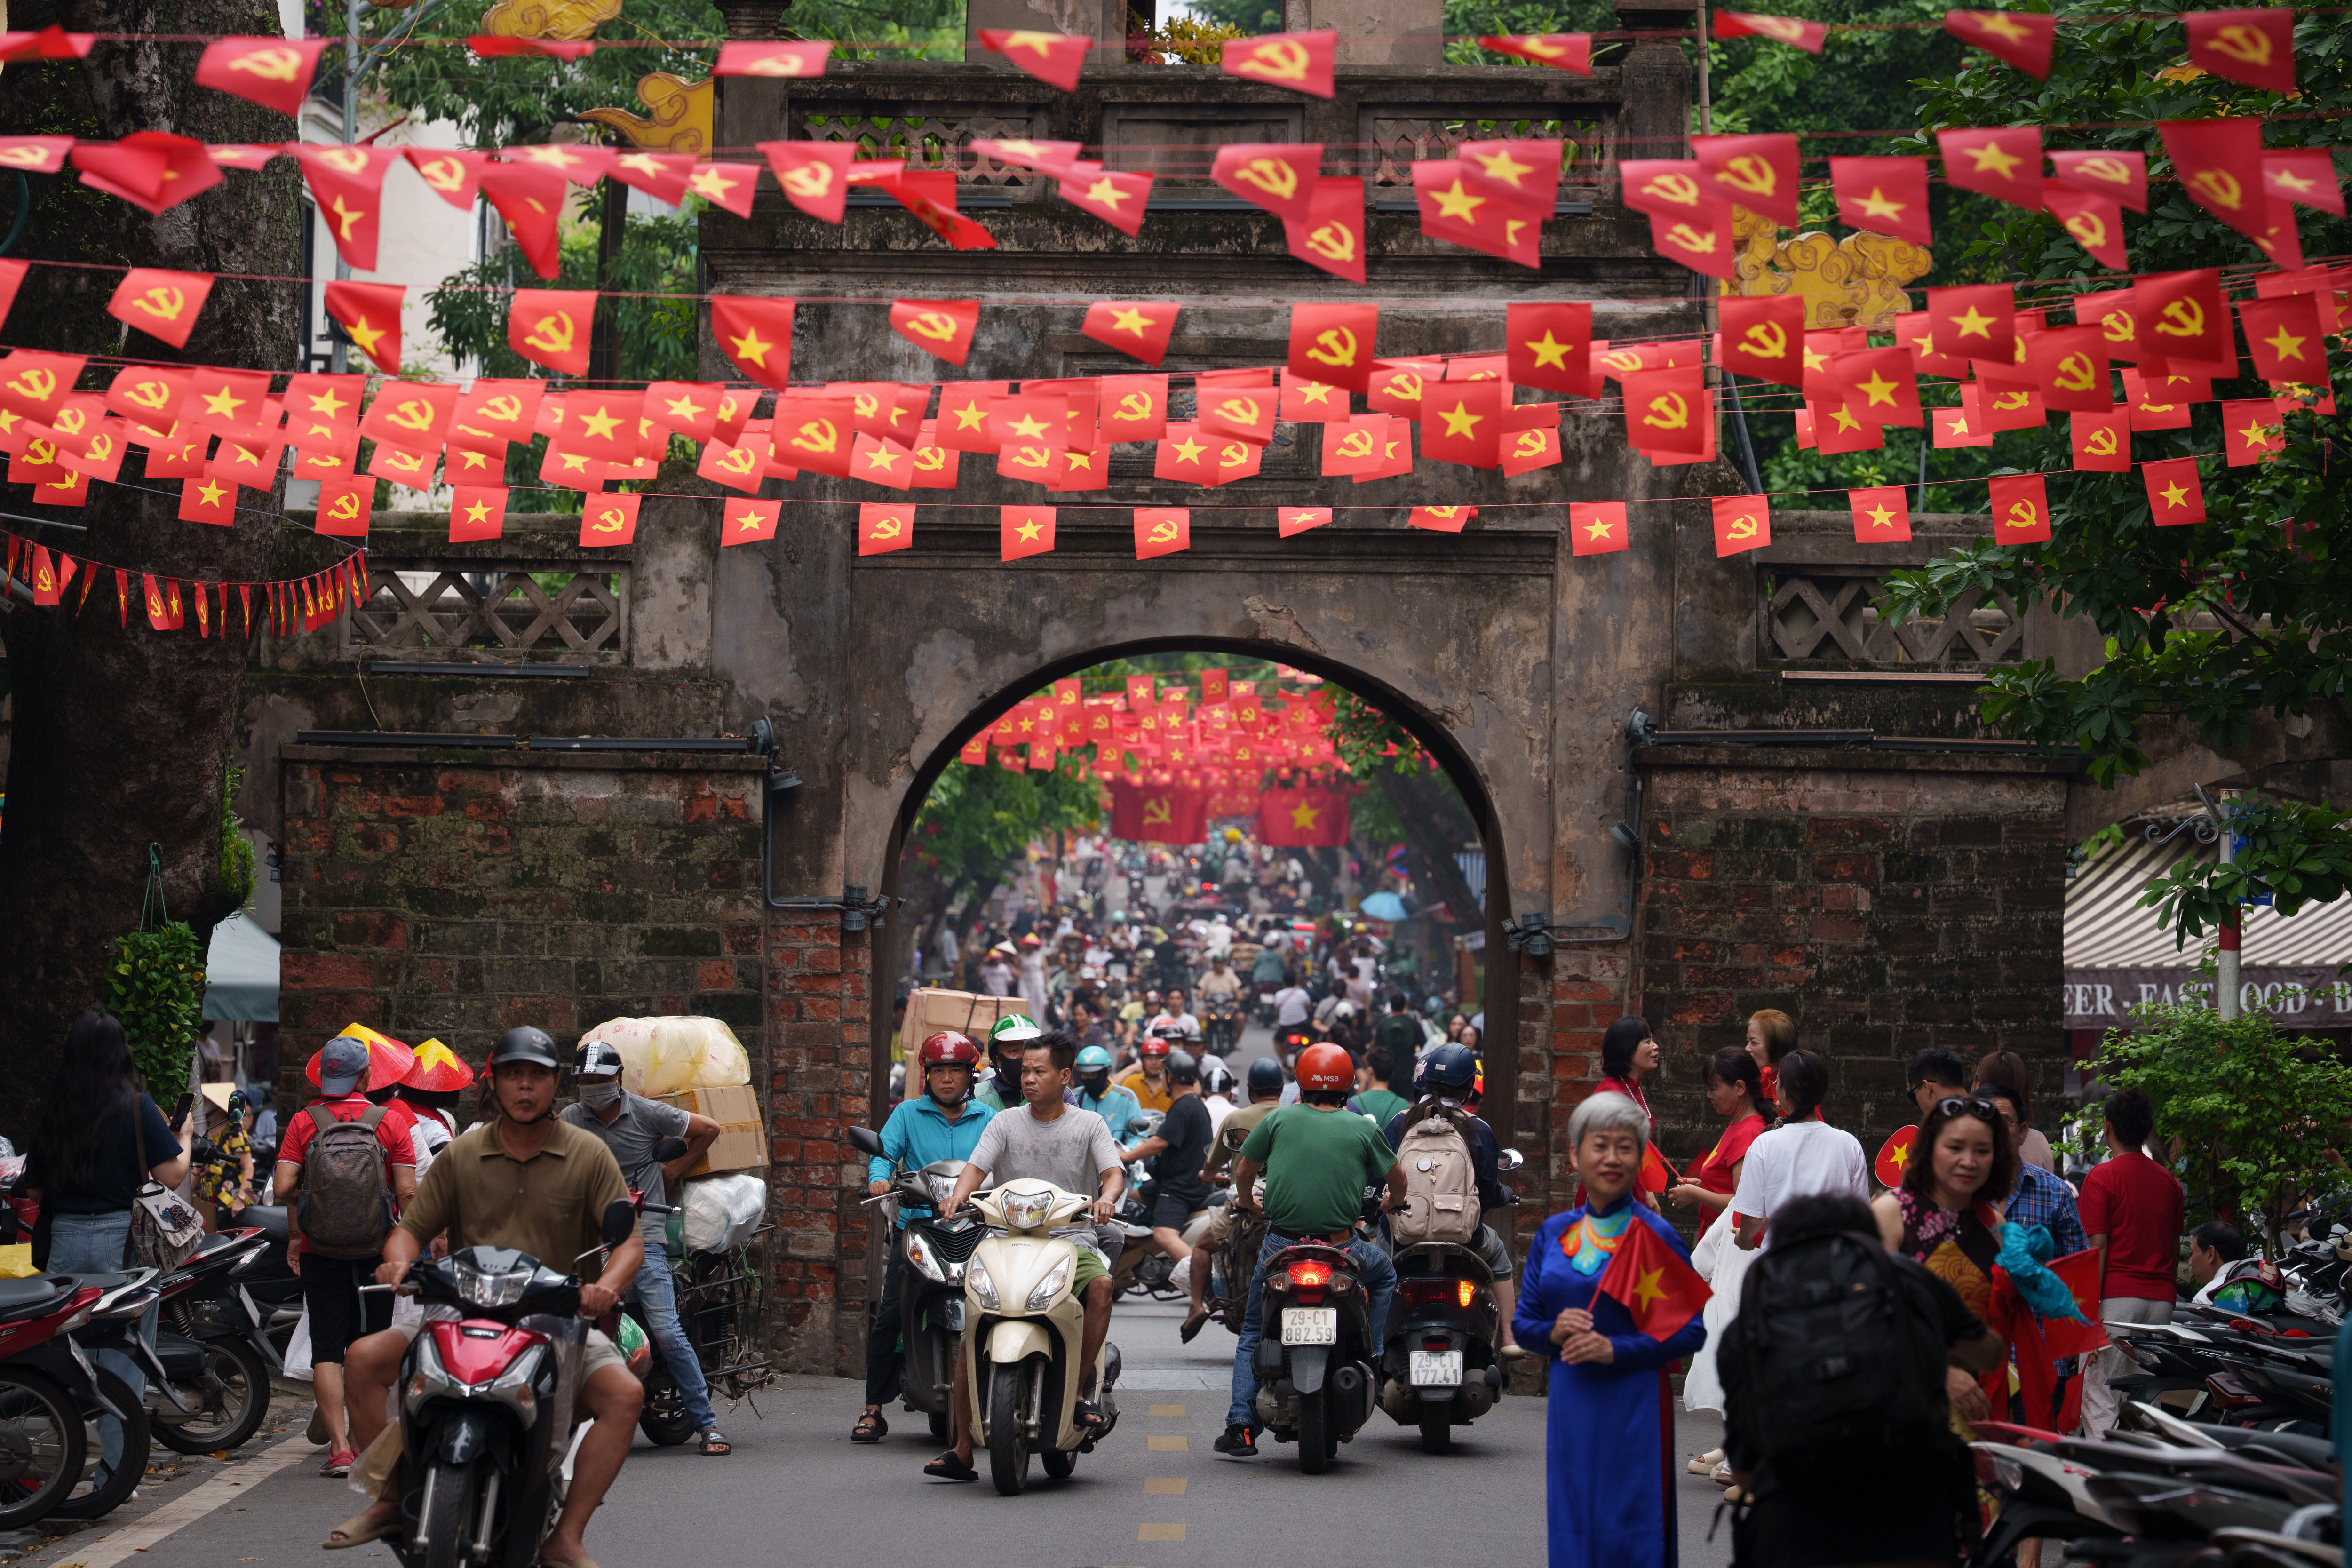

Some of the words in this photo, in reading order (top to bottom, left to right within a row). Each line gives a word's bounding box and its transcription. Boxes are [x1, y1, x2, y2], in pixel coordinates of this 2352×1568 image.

[1290, 1311, 1327, 1325] 29-C1
[1286, 1327, 1332, 1342] 882.59
[1418, 1353, 1453, 1368] 29-C1
[1415, 1369, 1457, 1384] 177.41
